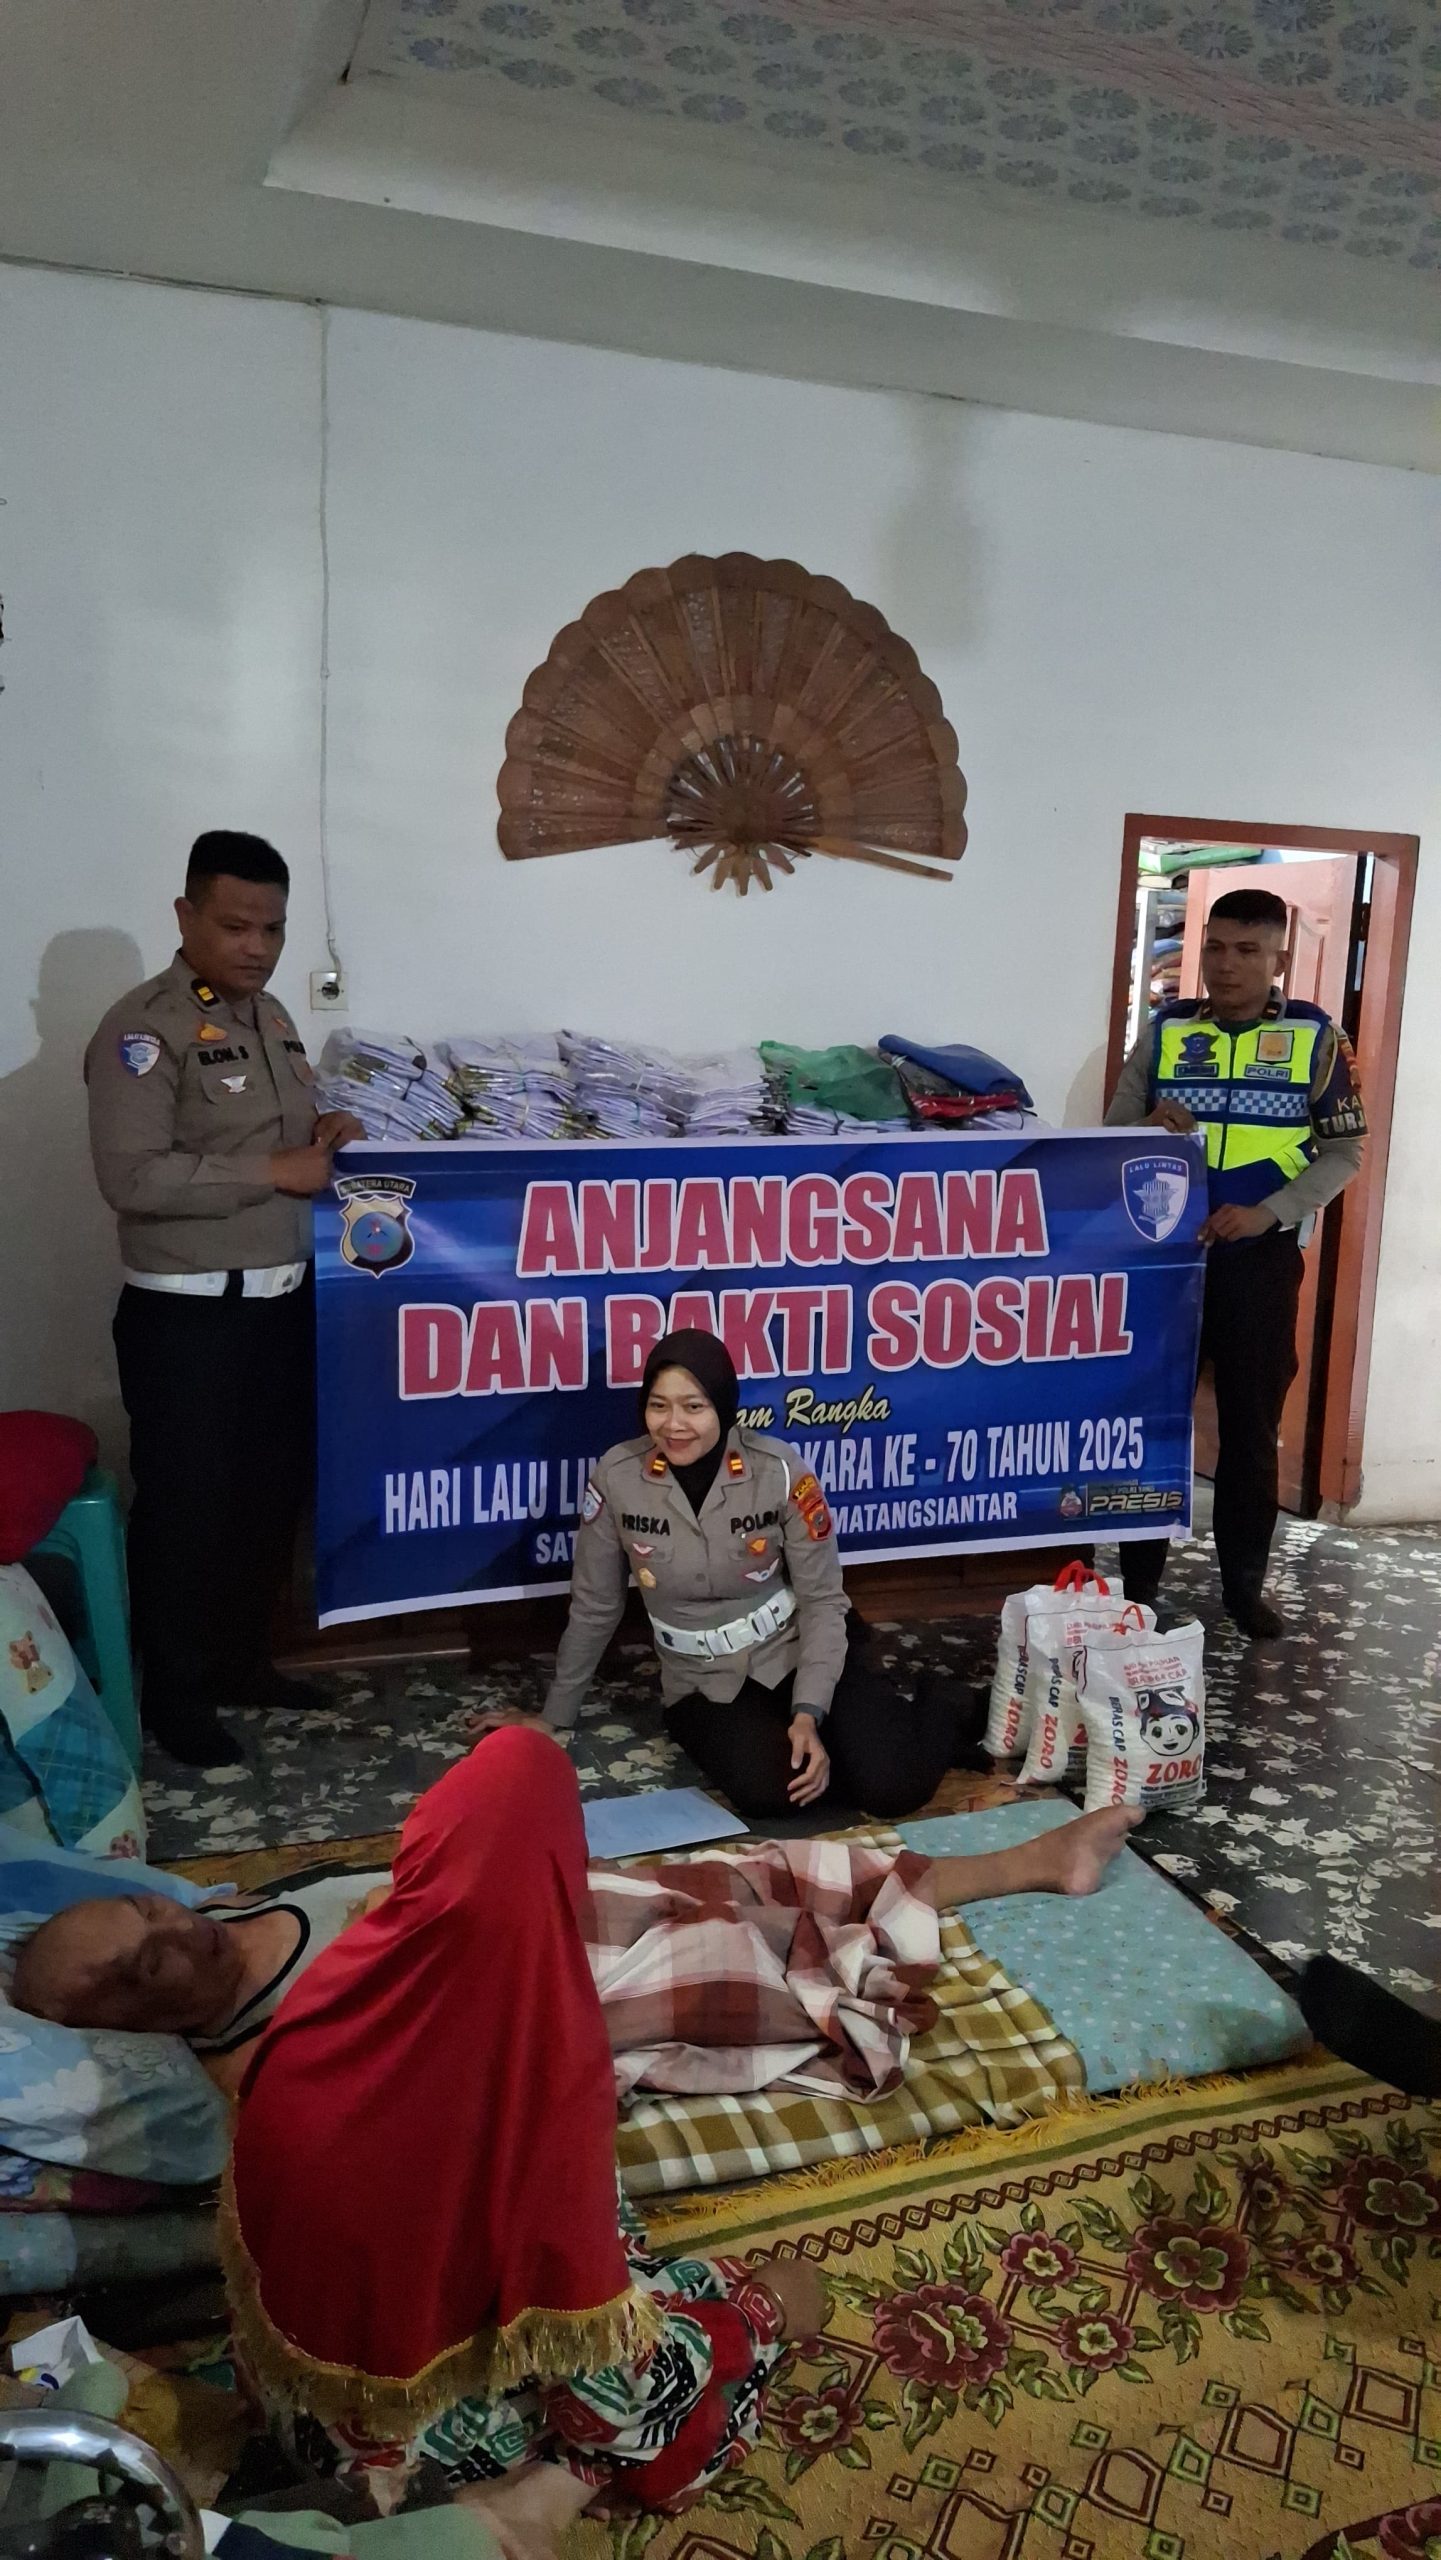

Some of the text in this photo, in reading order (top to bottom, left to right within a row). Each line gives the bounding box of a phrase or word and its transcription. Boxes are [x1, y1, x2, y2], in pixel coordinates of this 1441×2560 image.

[1247, 1067, 1288, 1078] POLRI
[384, 1179, 410, 1192] UTARA
[1129, 1162, 1182, 1173] LALU LINTAS
[517, 1168, 1049, 1279] ANJANGSANA
[399, 1296, 588, 1400] DAN
[867, 1272, 1133, 1373] SOSIAL
[736, 1385, 891, 1434] am Rangka
[384, 1468, 461, 1534] HARI
[473, 1460, 548, 1524] LALU
[789, 1436, 874, 1493] KARA
[883, 1433, 918, 1488] KE
[925, 1458, 936, 1471] -
[947, 1429, 978, 1482] 70
[987, 1421, 1070, 1479] TAHUN
[1079, 1417, 1144, 1471] 2025
[730, 1509, 779, 1534] POLRI
[831, 1491, 1018, 1535] MATANGSIANTAR
[1003, 1697, 1023, 1750] ZORO
[1041, 1714, 1058, 1769] ZORO
[1112, 1729, 1126, 1752] CAP
[1112, 1756, 1128, 1806] ZORO
